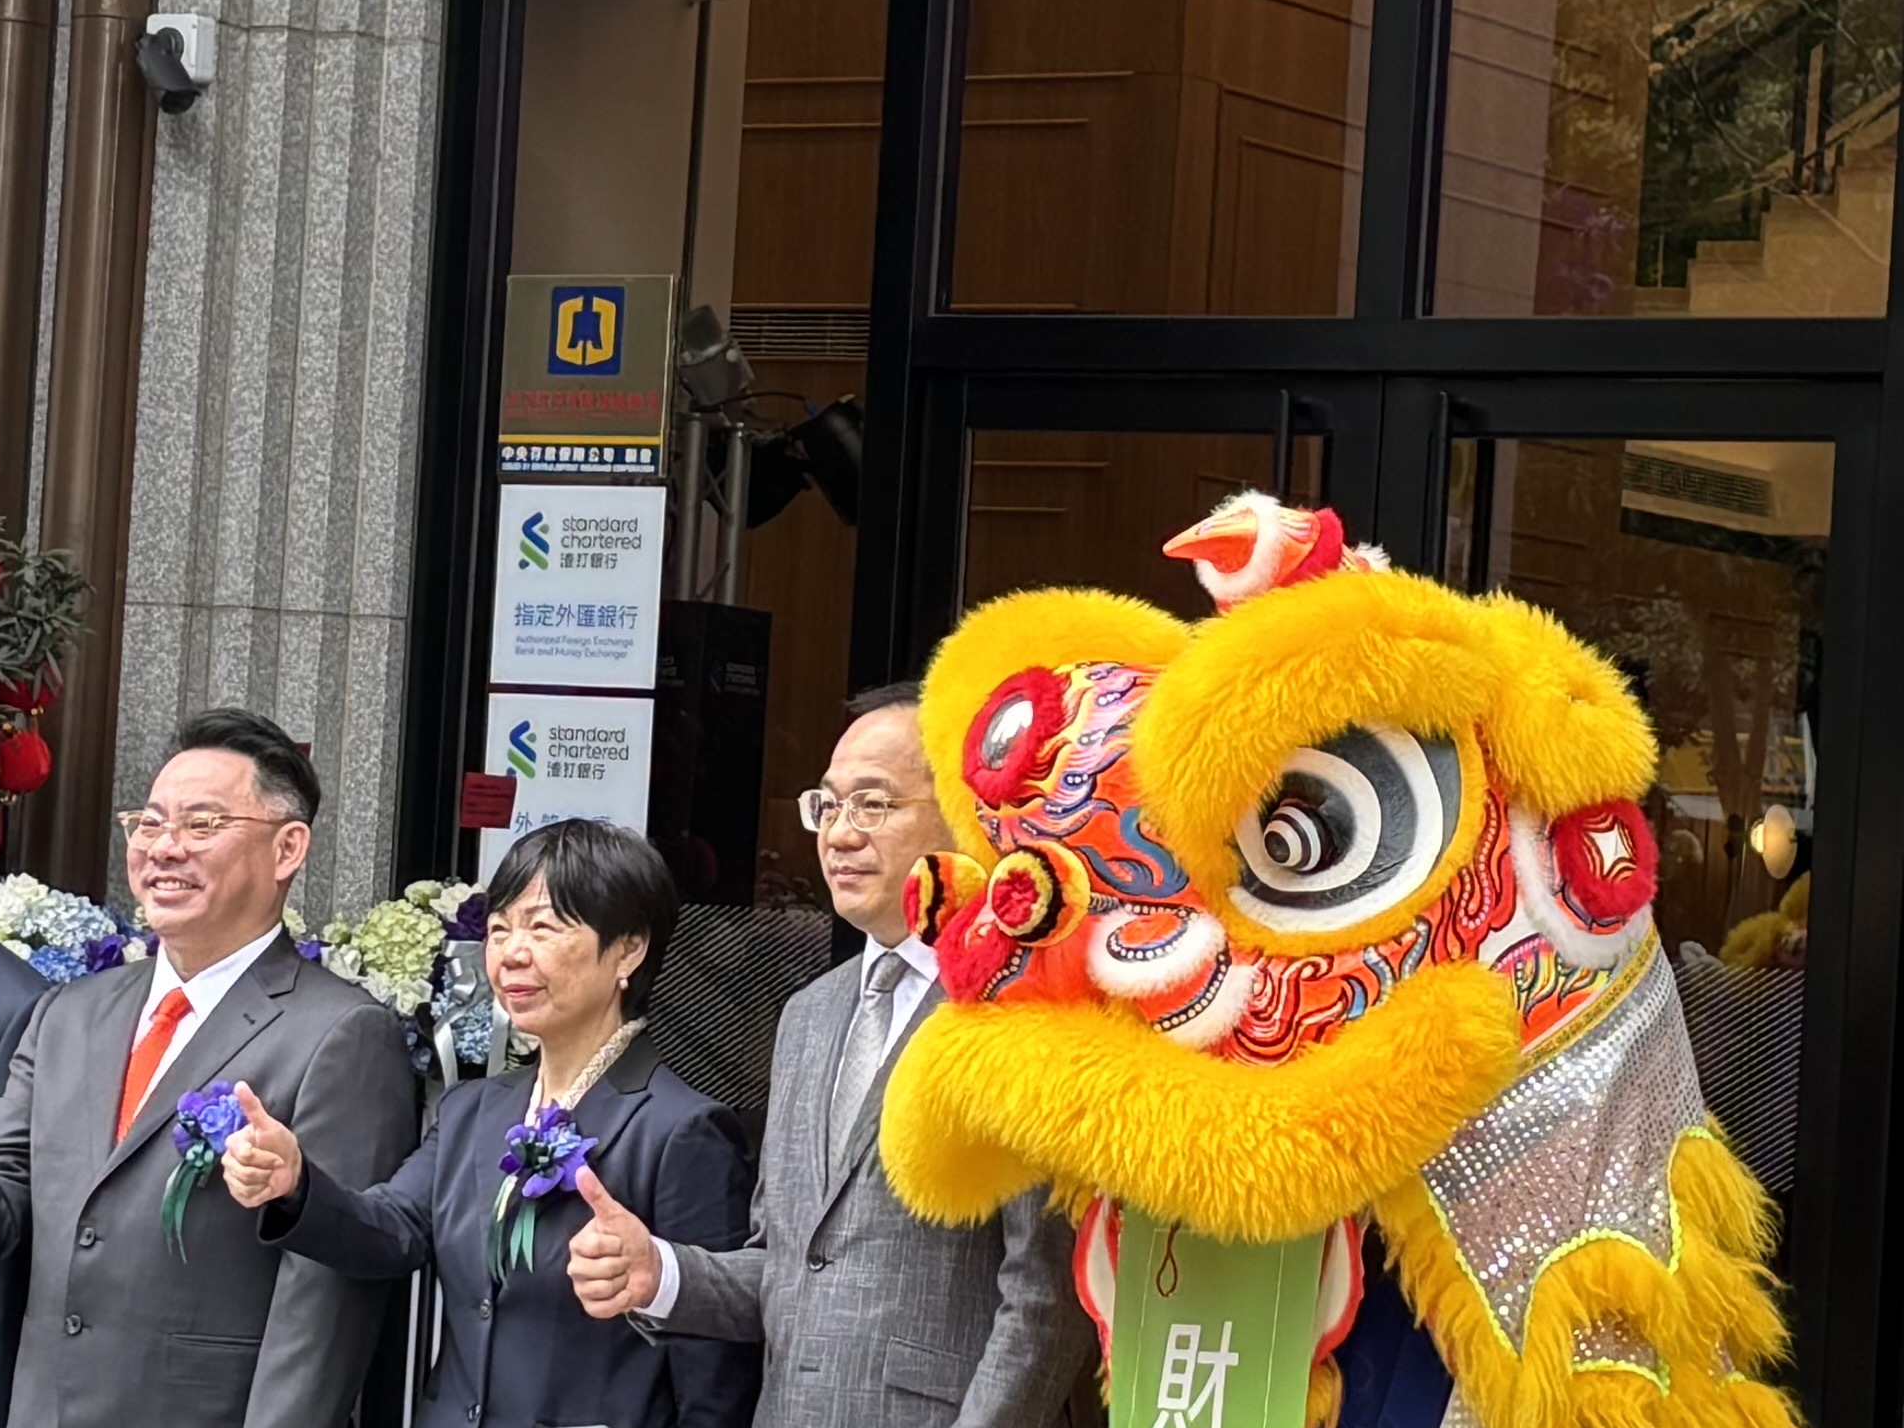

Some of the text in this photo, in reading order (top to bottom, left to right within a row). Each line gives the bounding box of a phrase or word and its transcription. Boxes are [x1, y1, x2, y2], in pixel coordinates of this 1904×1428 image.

[561, 515, 639, 533] standard
[560, 533, 642, 550] chartered
[514, 601, 639, 630] 指定外匯銀行
[548, 725, 626, 743] standard
[548, 743, 630, 761] chartered
